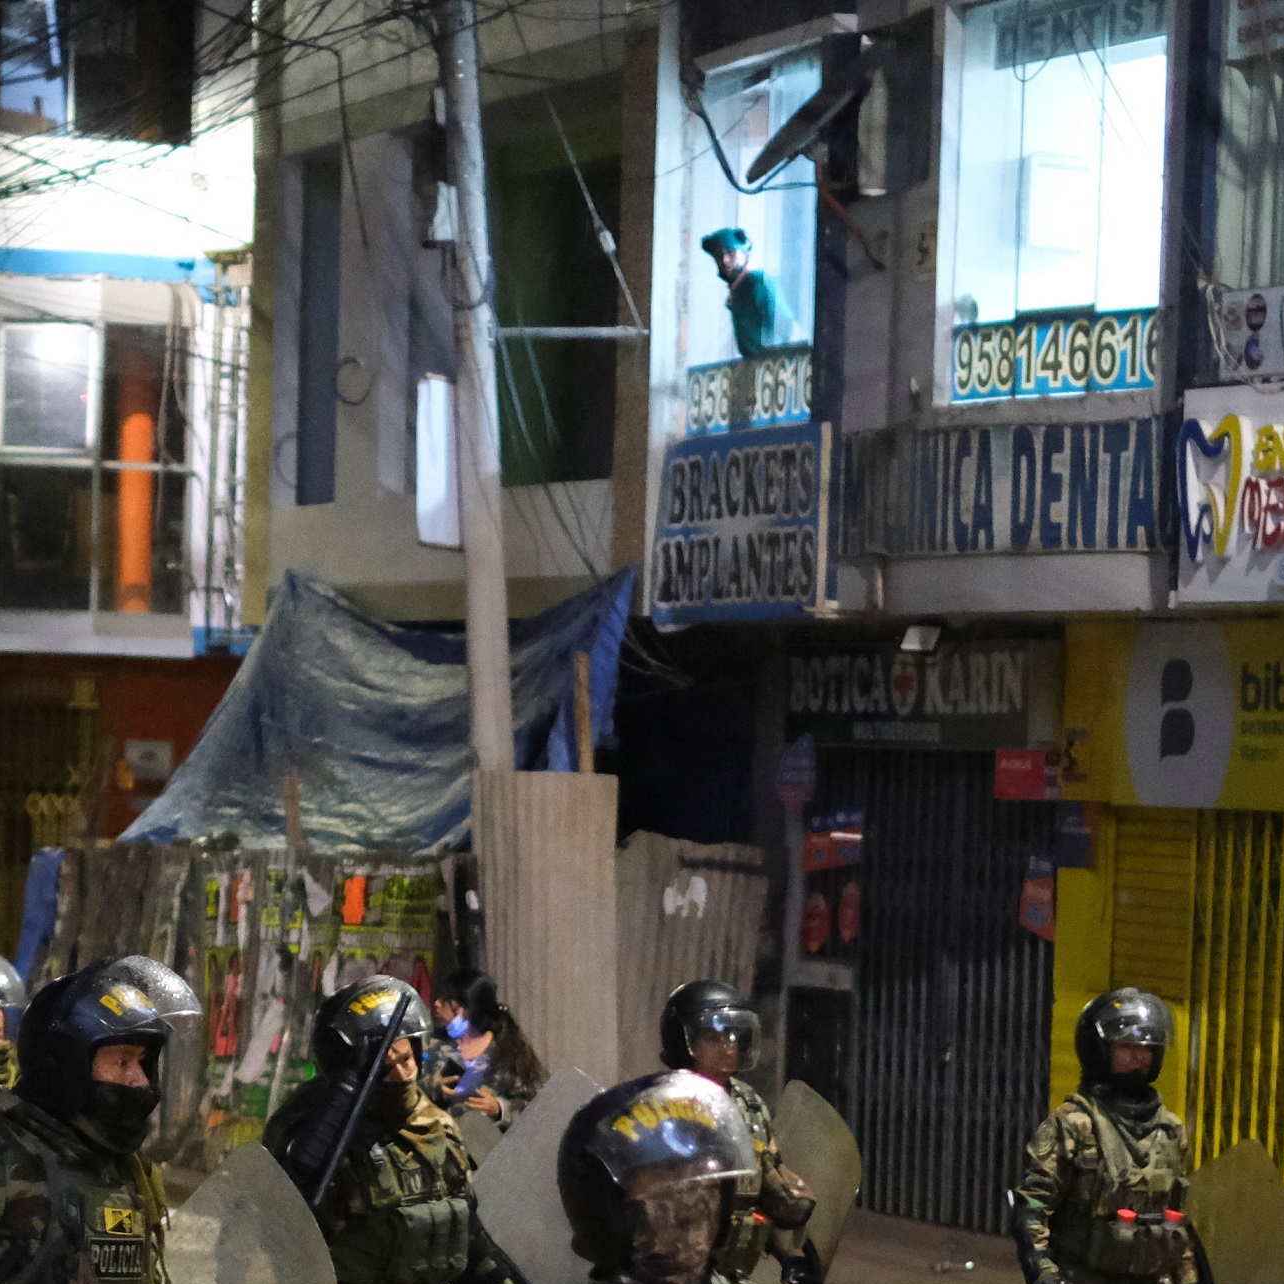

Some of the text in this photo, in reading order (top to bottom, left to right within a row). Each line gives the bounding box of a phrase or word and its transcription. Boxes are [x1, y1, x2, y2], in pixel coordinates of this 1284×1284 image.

[669, 445, 814, 524] BRACKETS
[789, 650, 1024, 714] BOTICA KARIN
